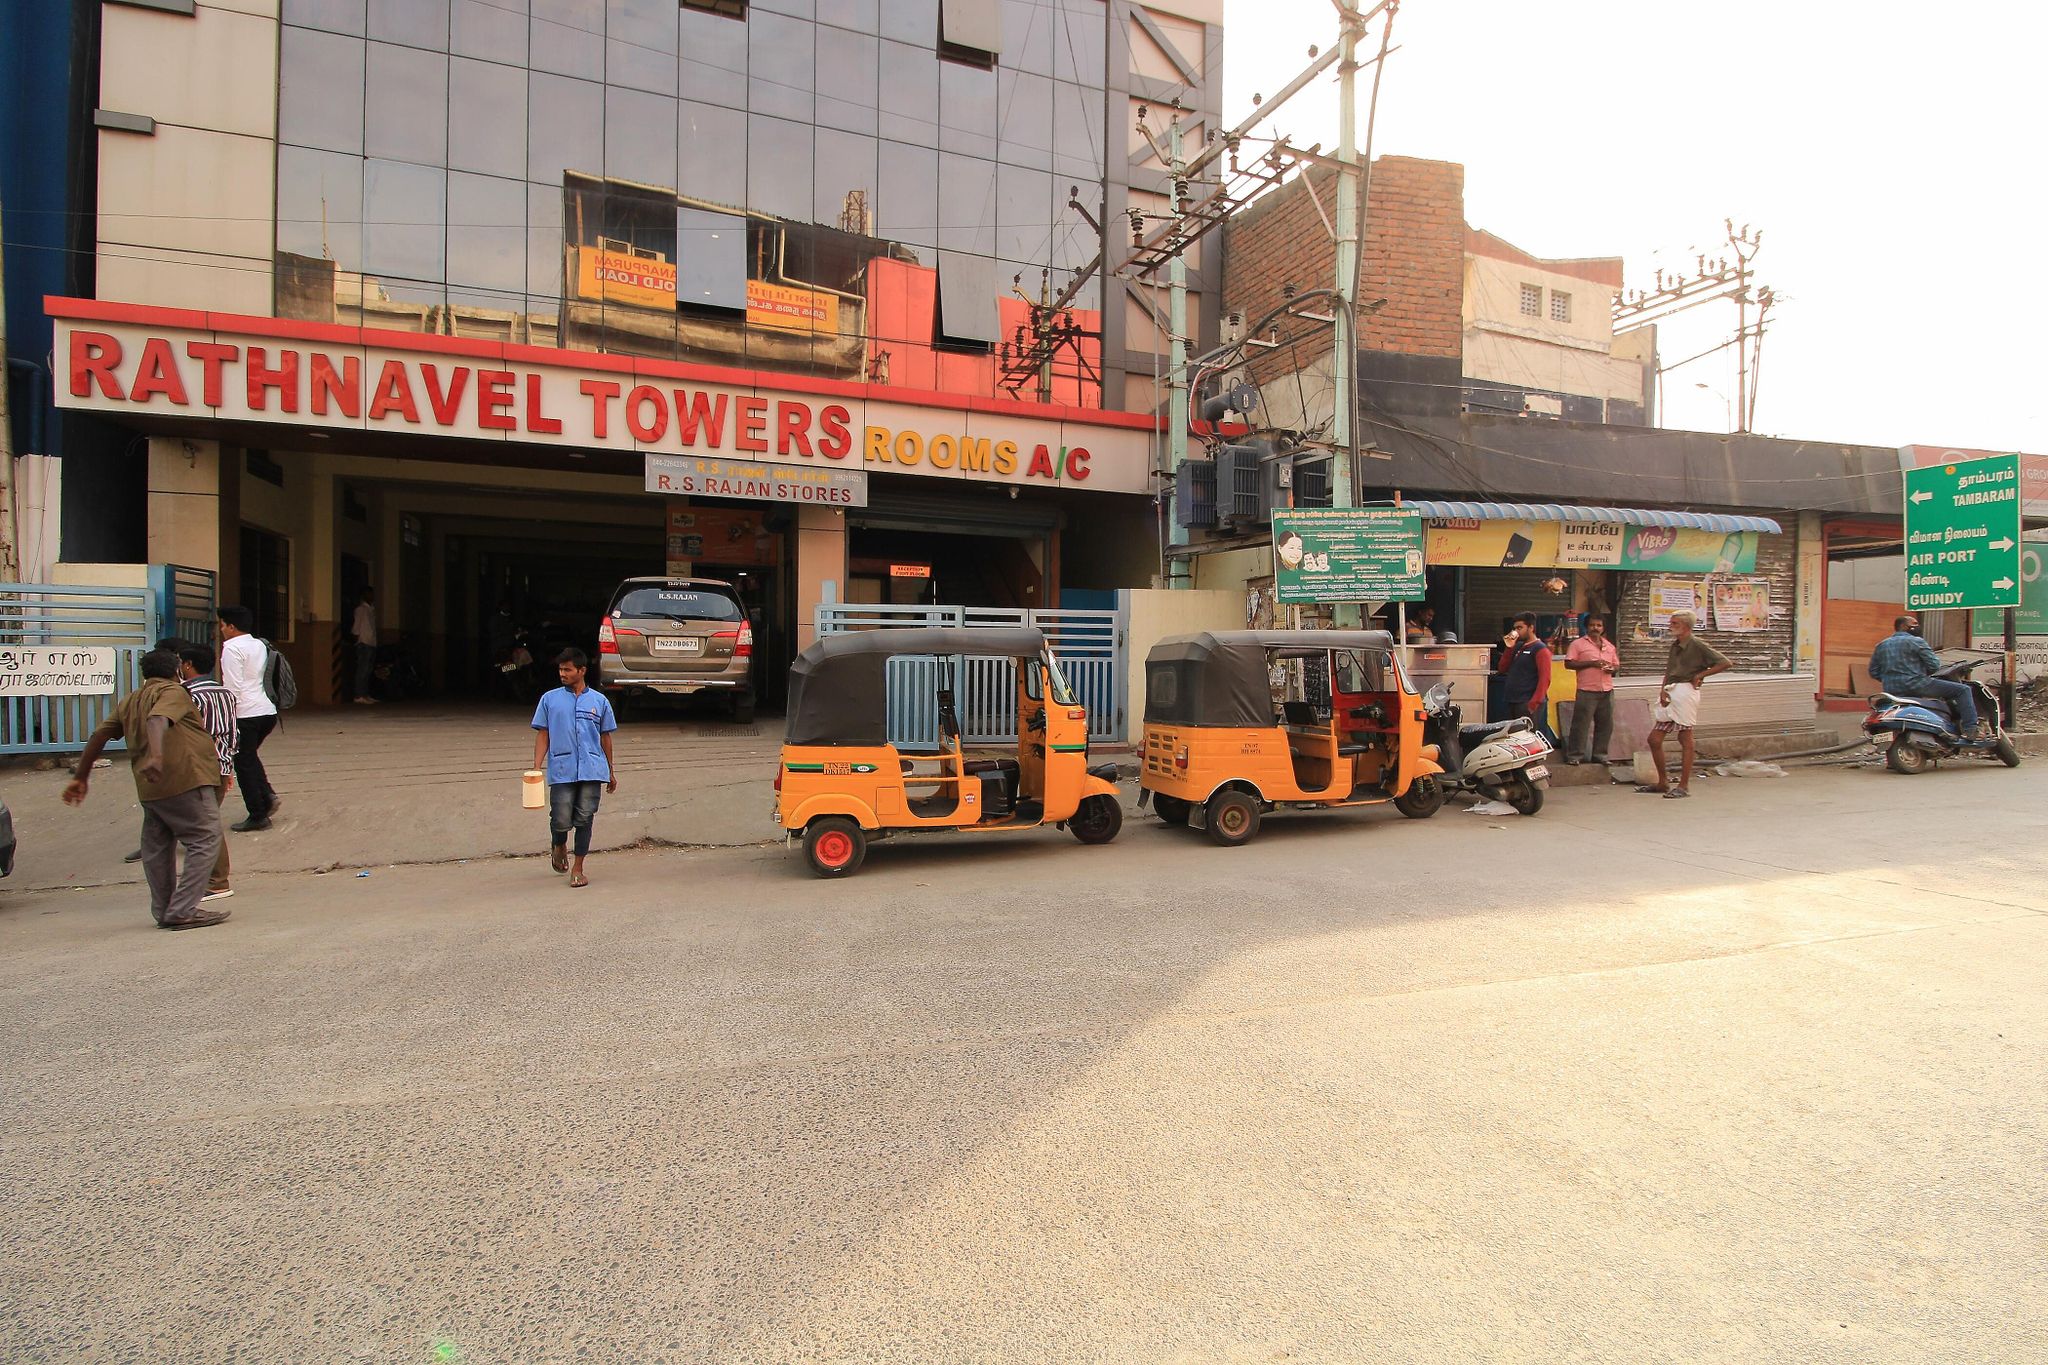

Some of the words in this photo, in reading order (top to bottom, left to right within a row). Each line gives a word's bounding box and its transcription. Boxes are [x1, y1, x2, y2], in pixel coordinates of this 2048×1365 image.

[69, 329, 563, 435] RATHNAVEL
[579, 378, 852, 460] TOWERS
[864, 426, 1018, 474] ROOMS
[1026, 444, 1092, 481] A/C
[1958, 466, 2015, 490] தாம்பரம்
[2026, 468, 2048, 480] GRO
[777, 484, 851, 503] STORES
[1953, 487, 2016, 507] TAMBARAM
[1566, 522, 1619, 536] பாம்பே
[1909, 530, 1942, 544] விமான
[1944, 524, 1988, 545] நிலையம்
[1637, 532, 1669, 551] VIBRO
[1910, 553, 1934, 566] AIR
[1938, 549, 1976, 564] PORT
[1909, 572, 1950, 587] கிண்டி
[1909, 592, 1964, 606] GUINDY
[2015, 653, 2048, 665] PLYWOO
